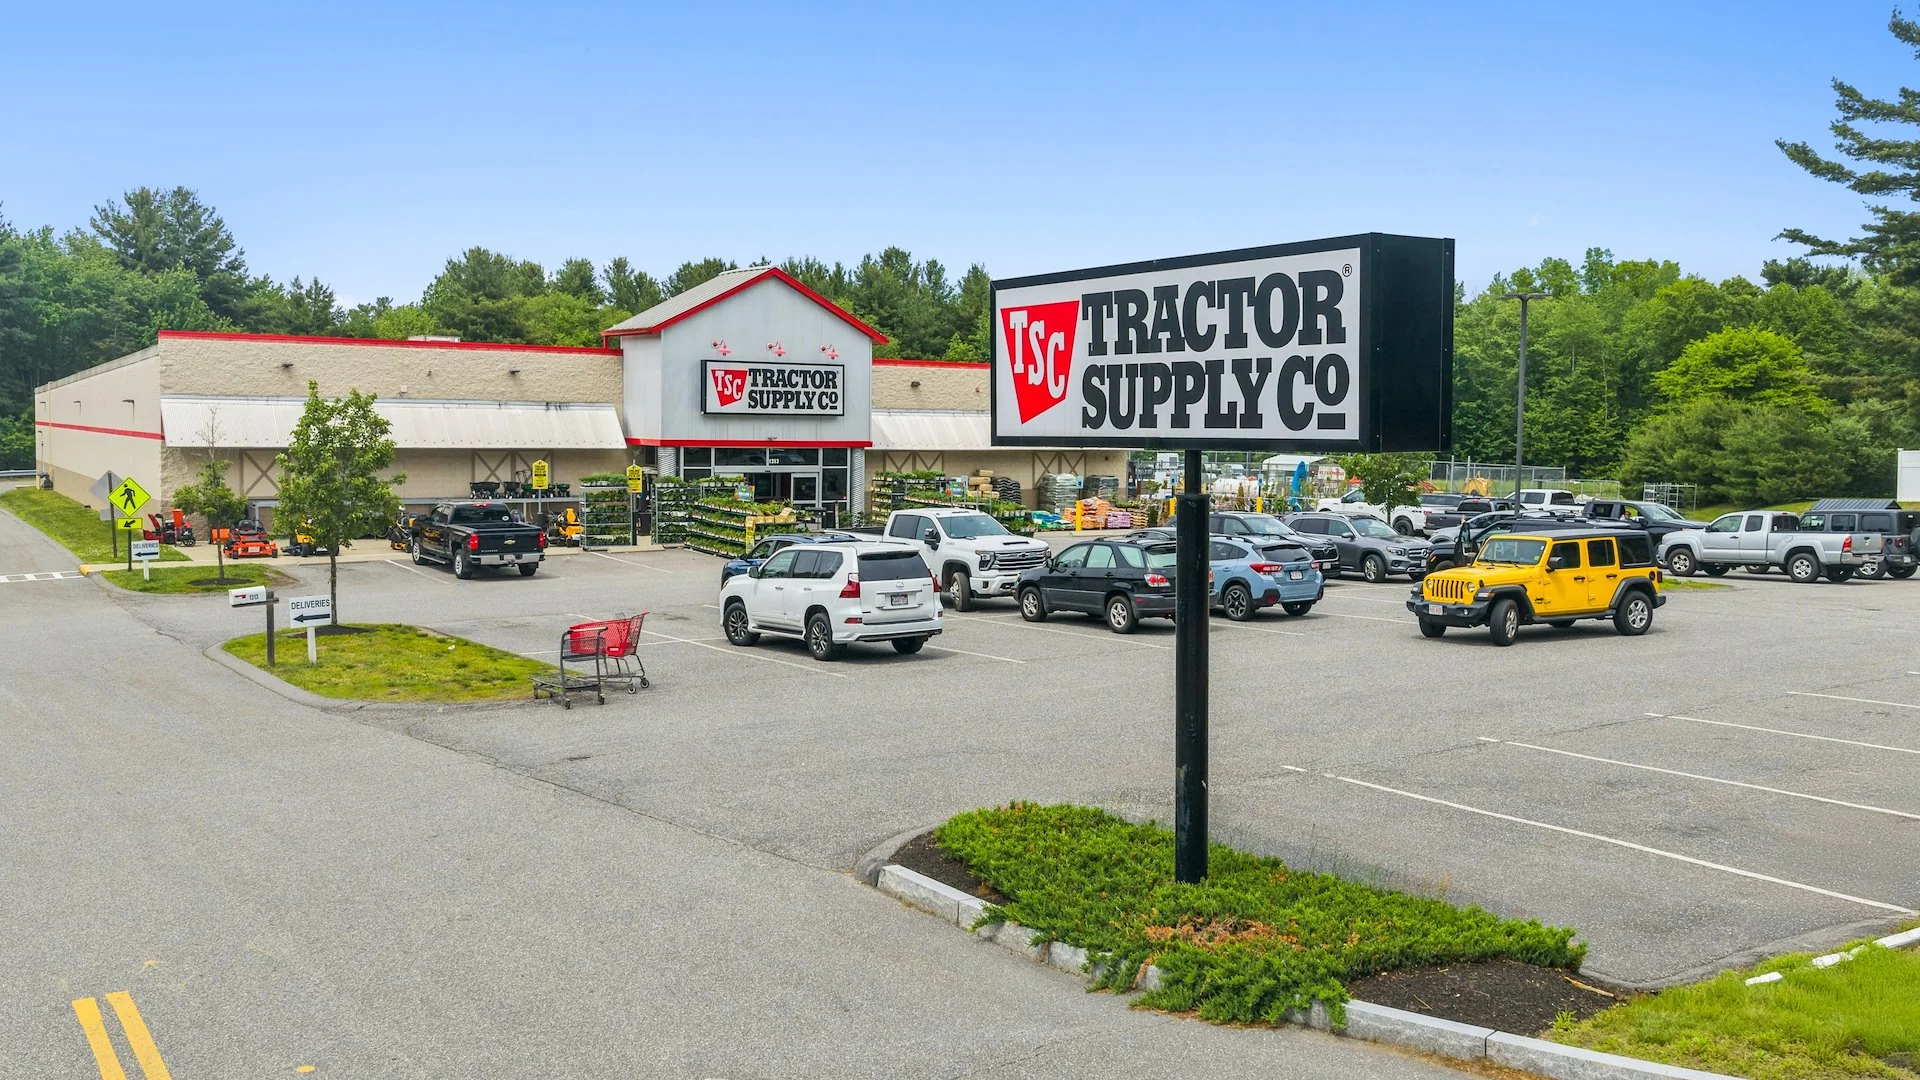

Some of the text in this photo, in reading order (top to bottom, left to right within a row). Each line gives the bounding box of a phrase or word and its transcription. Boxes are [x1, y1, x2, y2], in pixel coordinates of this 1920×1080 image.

[1081, 269, 1346, 356] TRACTOR
[1009, 310, 1065, 399] TSC
[715, 370, 742, 400] TSC
[748, 368, 838, 389] TRACTOR
[748, 389, 816, 410] SUPPLY
[1081, 357, 1272, 430] SUPPLY
[132, 542, 159, 550] DELIVERIES
[291, 599, 330, 610] DELIVERIES
